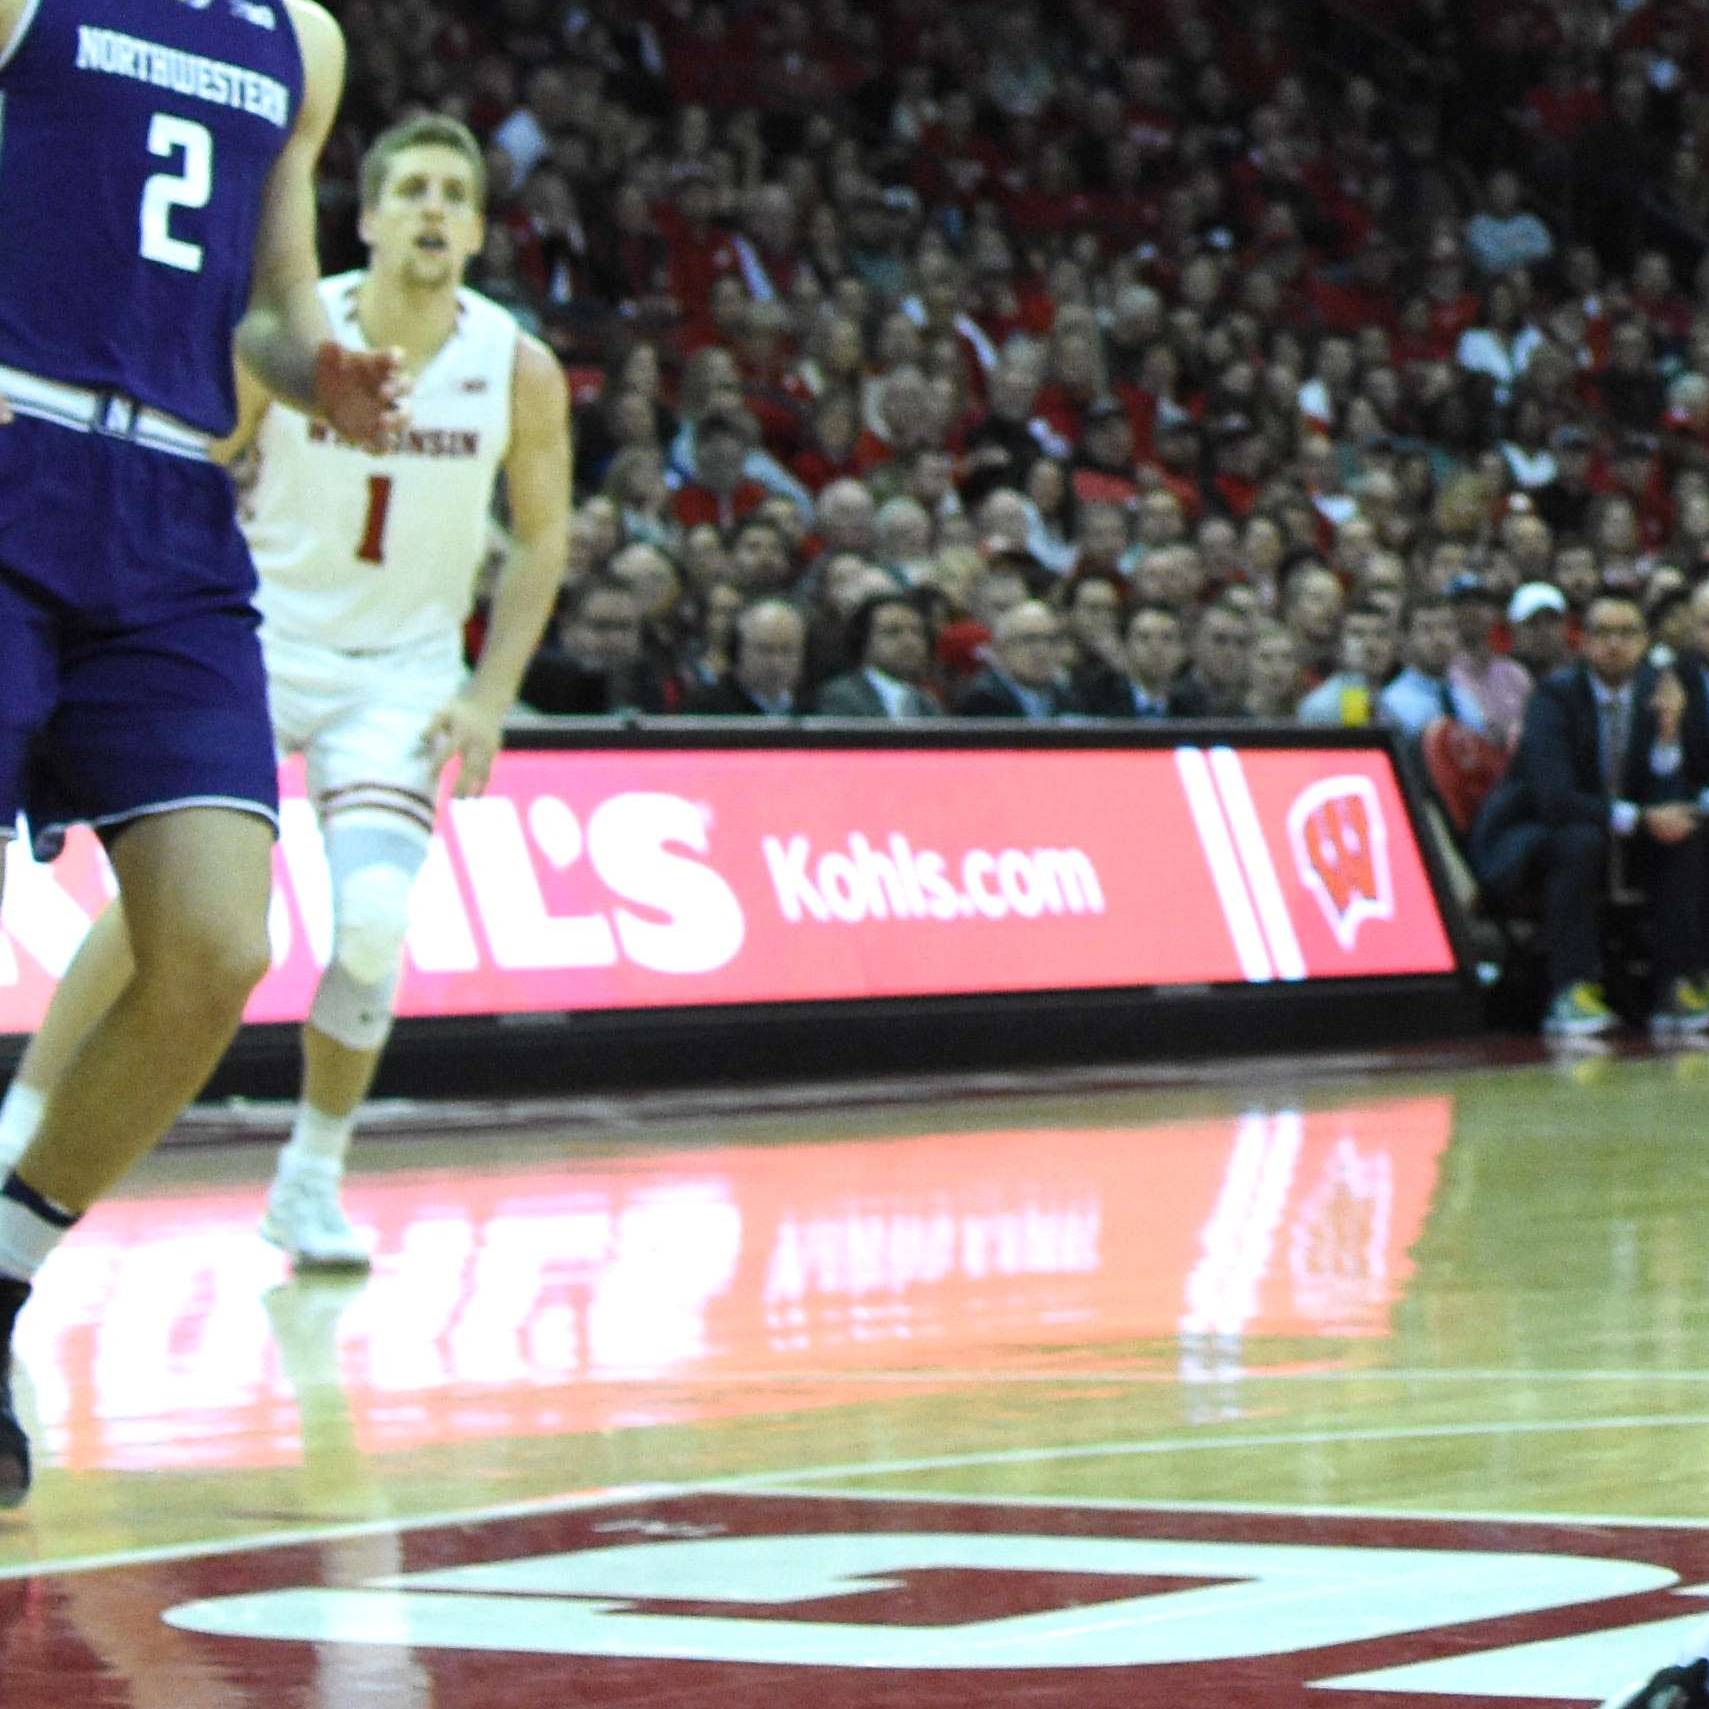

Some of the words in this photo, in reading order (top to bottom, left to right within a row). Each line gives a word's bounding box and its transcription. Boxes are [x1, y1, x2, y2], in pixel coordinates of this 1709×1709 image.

[76, 25, 289, 128] NORTHWESTERN
[140, 113, 213, 272] 2
[356, 475, 392, 564] 1
[762, 832, 1105, 922] Kohls.com
